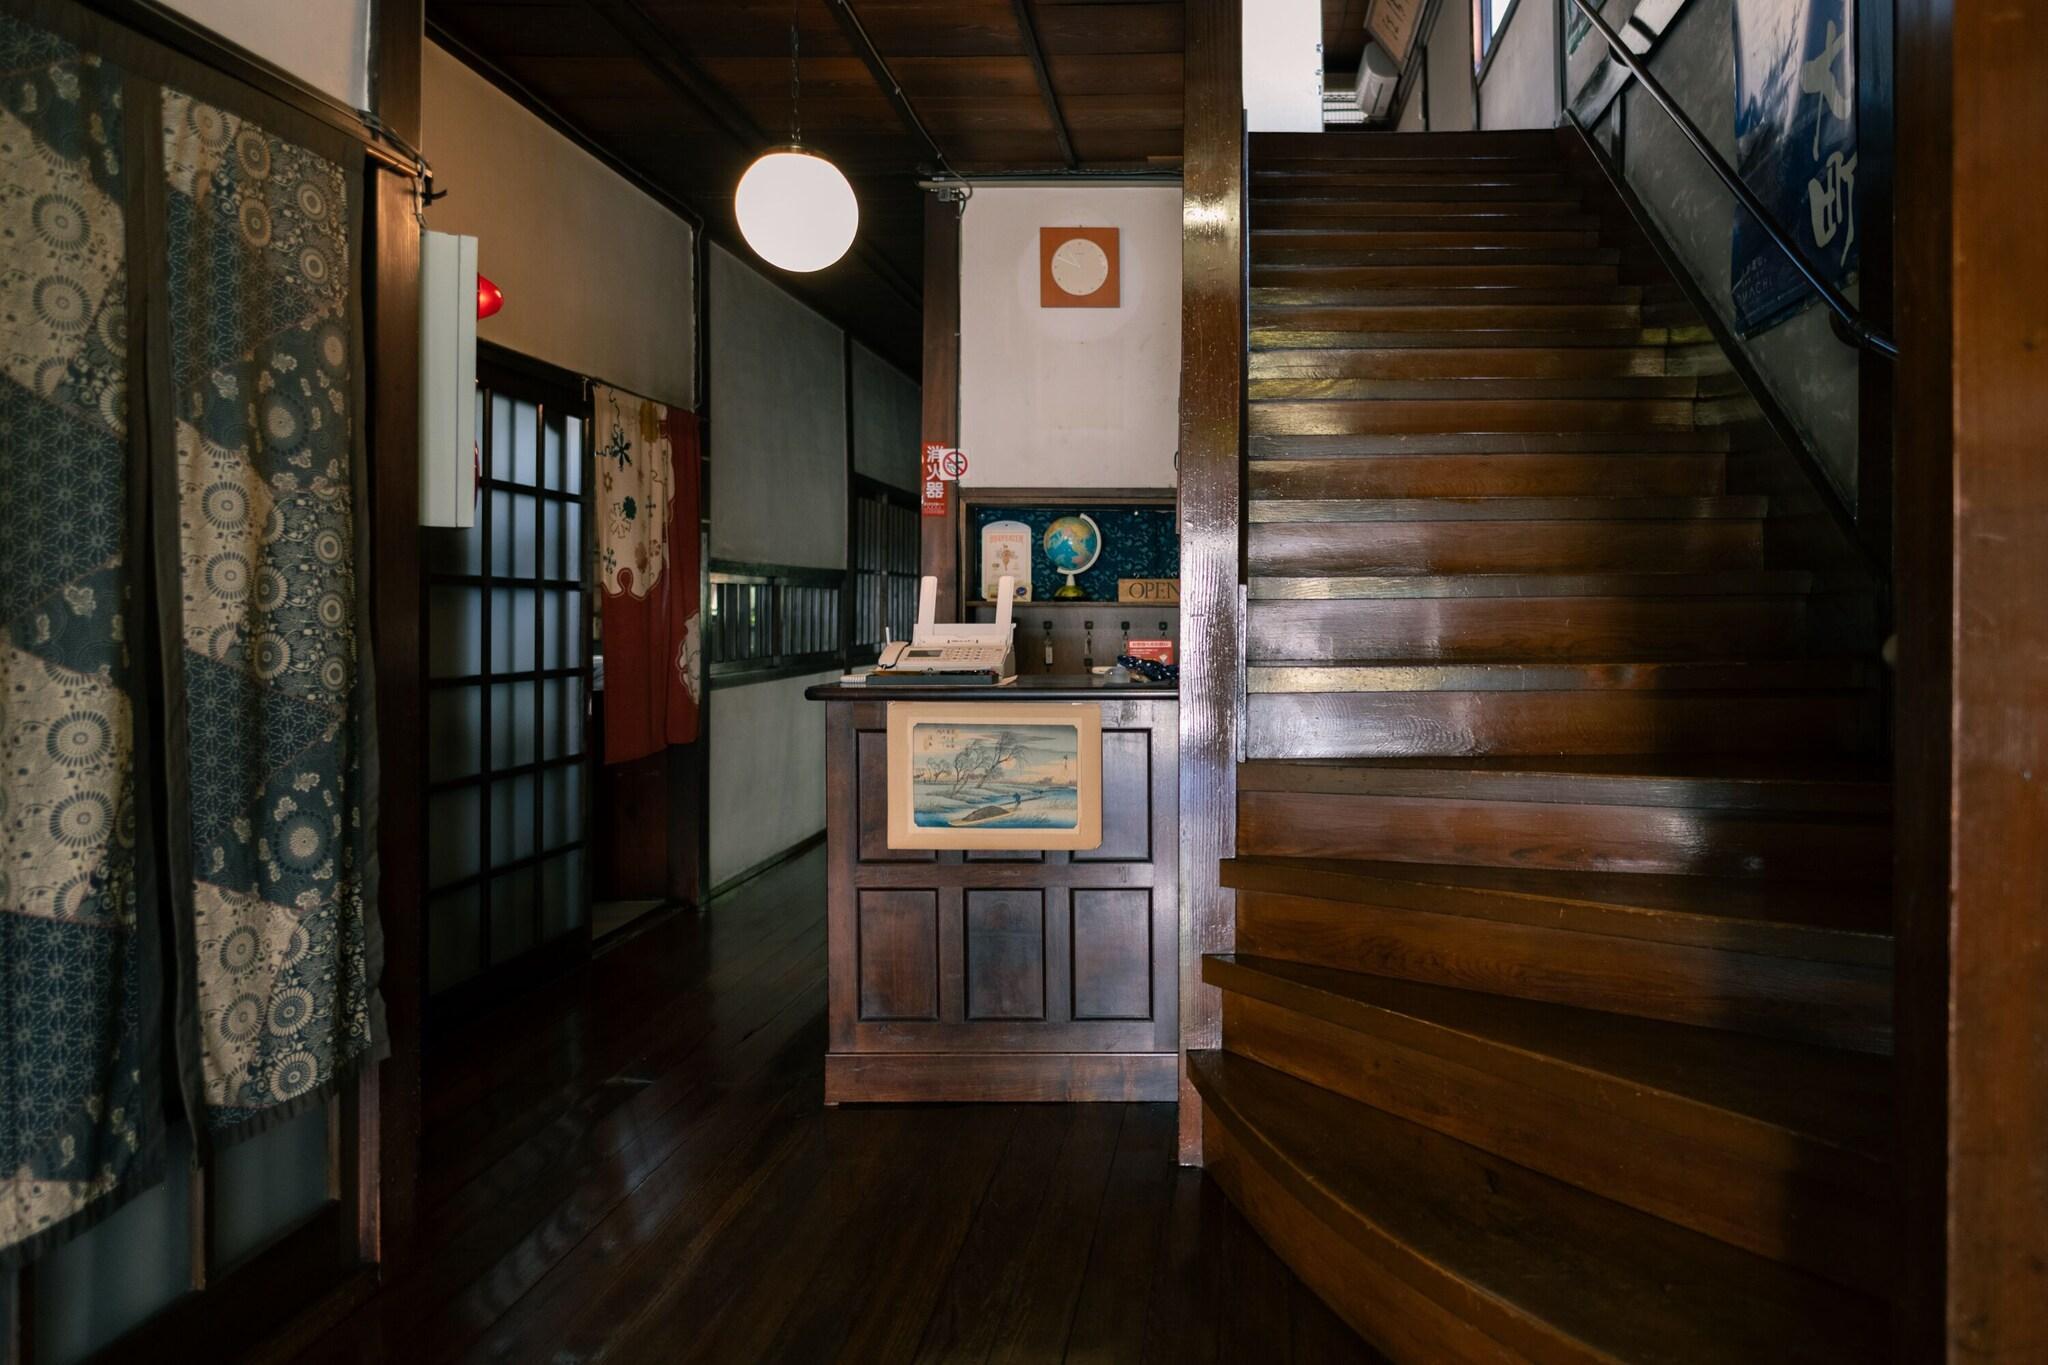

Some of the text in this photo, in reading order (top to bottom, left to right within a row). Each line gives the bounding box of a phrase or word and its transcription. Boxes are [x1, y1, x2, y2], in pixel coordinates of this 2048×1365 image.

[926, 445, 945, 499] 消火器
[1128, 582, 1180, 600] OPEN
